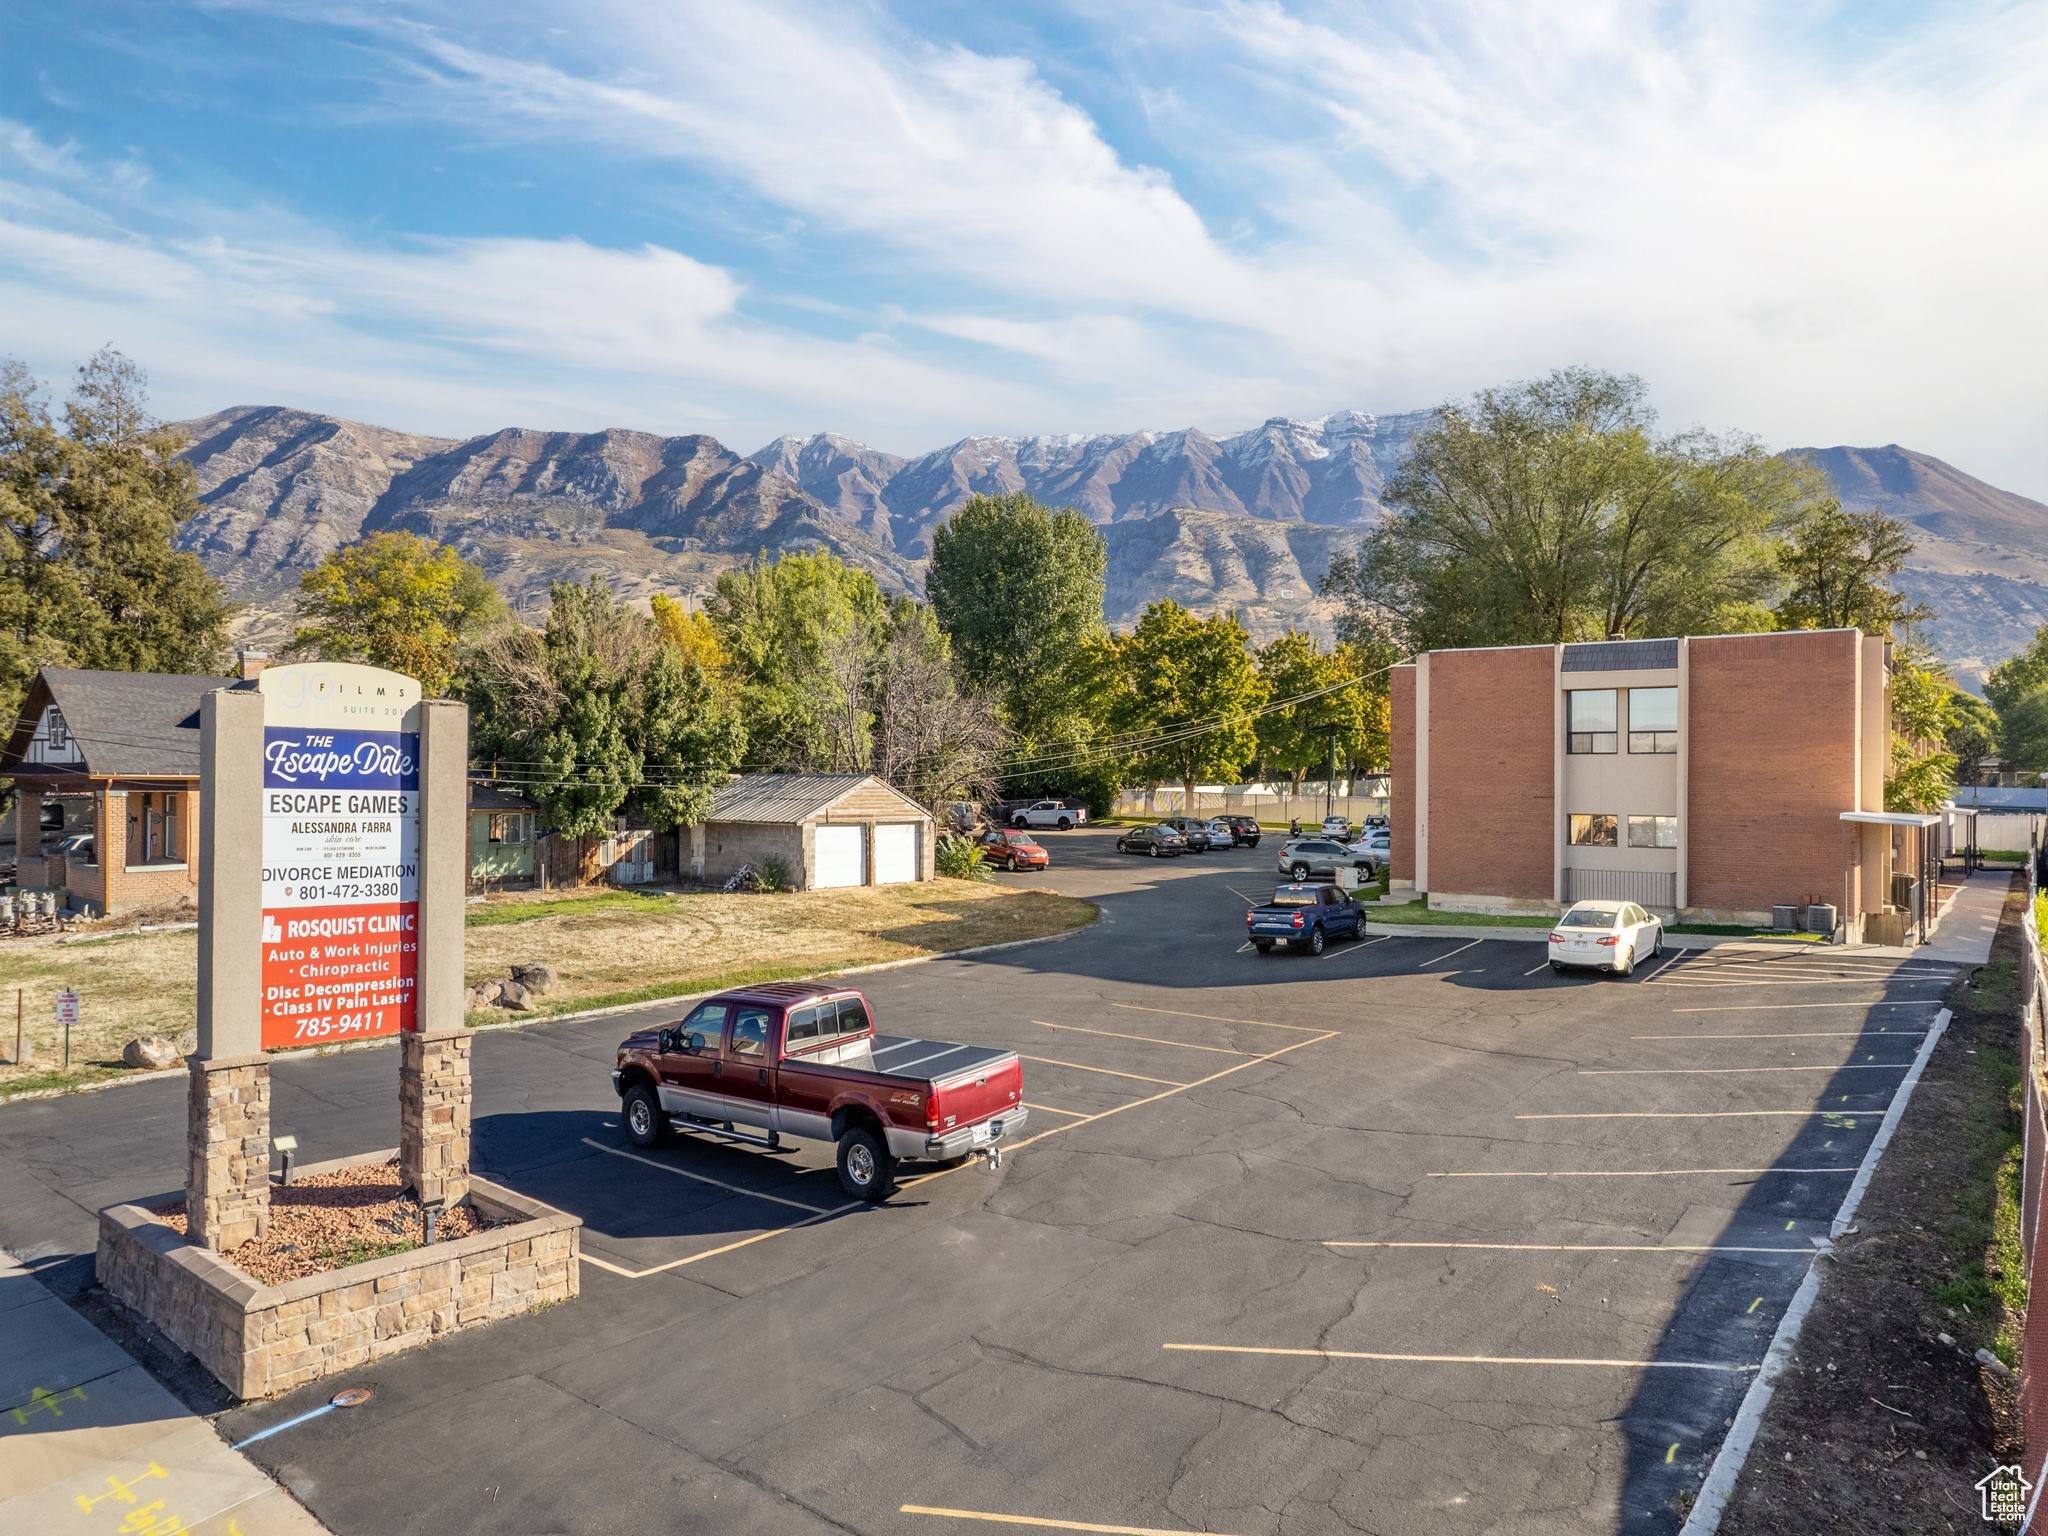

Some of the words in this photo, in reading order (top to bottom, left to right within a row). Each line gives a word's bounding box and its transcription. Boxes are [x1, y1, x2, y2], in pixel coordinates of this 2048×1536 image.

[319, 683, 405, 697] FILMS
[343, 706, 376, 715] SUITE
[384, 707, 404, 716] 201
[306, 735, 334, 748] THE
[265, 740, 355, 783] Escape
[353, 741, 414, 777] Date
[270, 794, 342, 813] ESCAPE
[348, 795, 408, 814] GAMES
[291, 822, 357, 834] ALESSANDRA
[362, 821, 392, 833] FARRA
[262, 867, 333, 882] DIVORCE
[337, 864, 416, 880] MEDIATION
[299, 882, 399, 900] 801-472-3380
[288, 916, 366, 938] ROSQUIST
[368, 914, 415, 934] CLINIC
[268, 949, 305, 962] Auto
[310, 946, 320, 959] &
[324, 943, 361, 957] Work
[365, 940, 417, 957] Injuries
[299, 959, 390, 978] Chiropractic
[267, 985, 300, 1000] Disc
[304, 975, 414, 997] Decompression
[273, 1001, 313, 1016] Class
[317, 997, 333, 1012] IV
[337, 994, 368, 1010] Pain
[372, 992, 410, 1006] Laser
[294, 1010, 384, 1039] 785-9411
